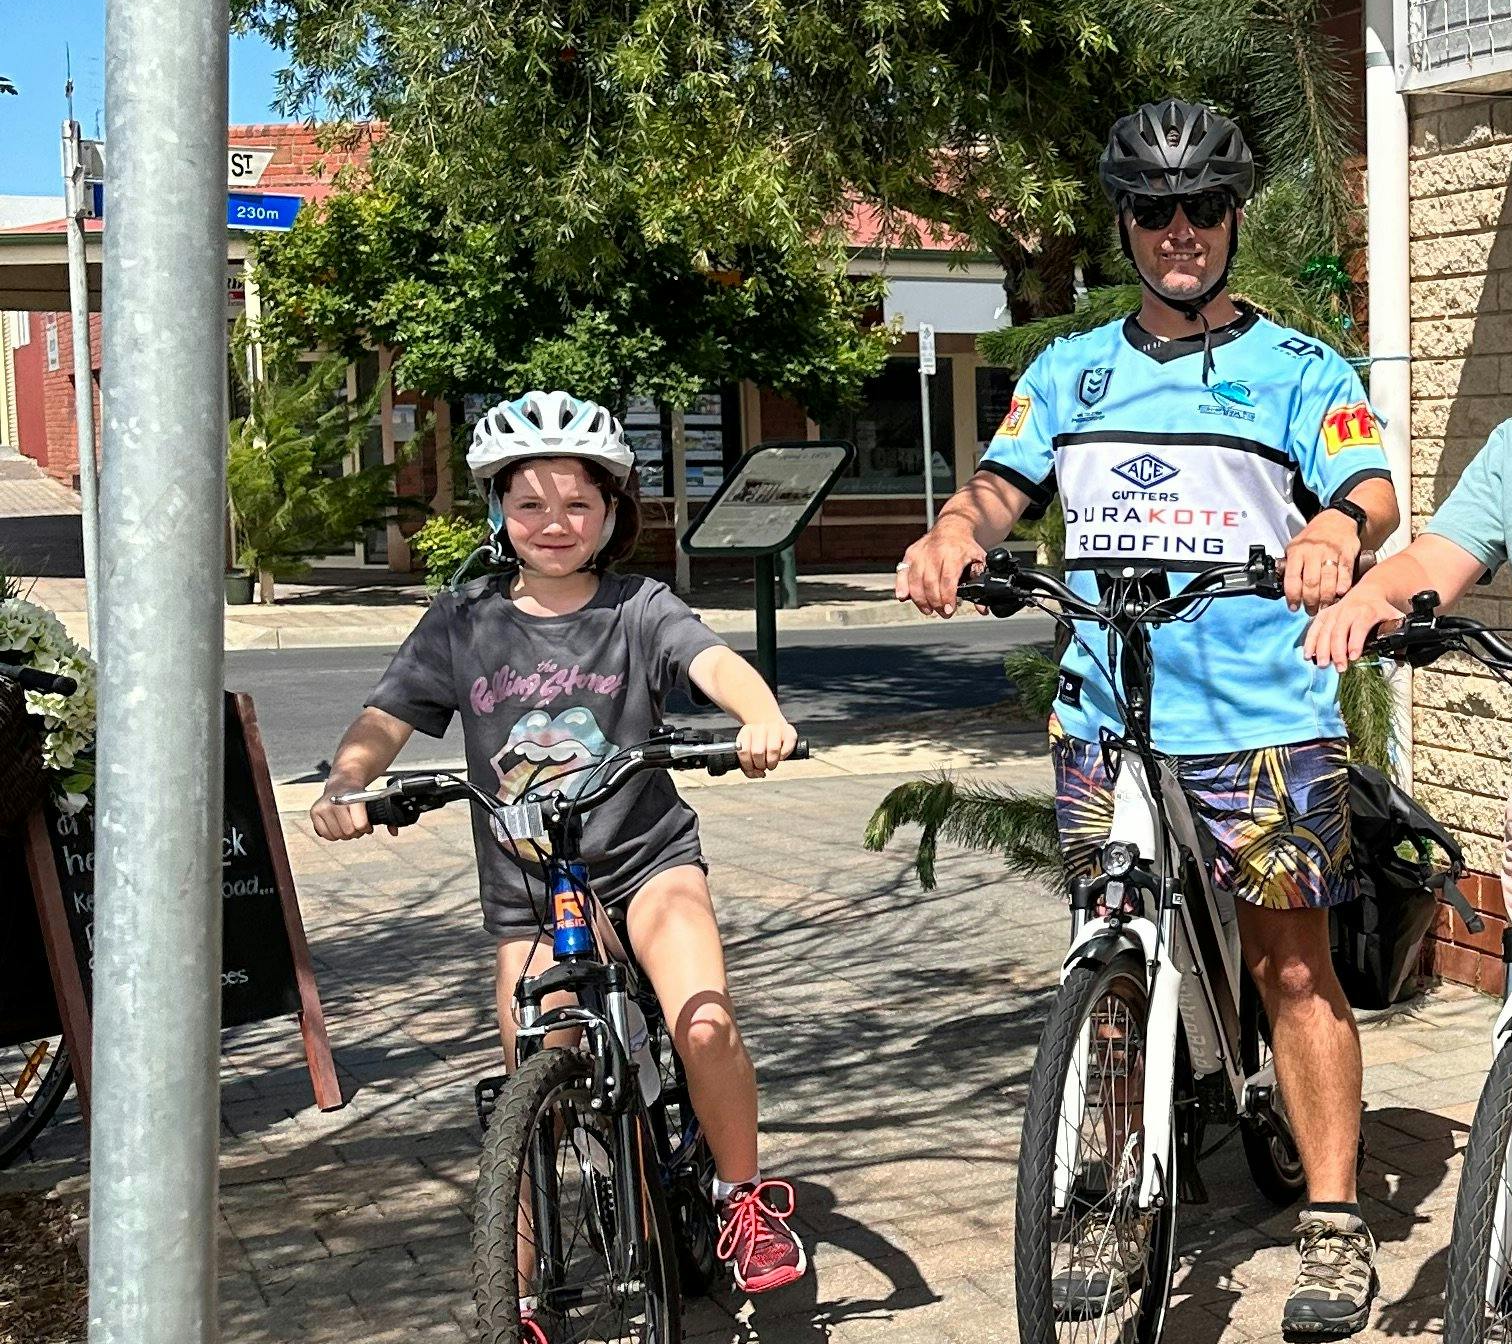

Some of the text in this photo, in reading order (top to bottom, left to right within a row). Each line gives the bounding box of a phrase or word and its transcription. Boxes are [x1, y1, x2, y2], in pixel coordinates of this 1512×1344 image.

[231, 153, 253, 177] ST
[236, 207, 279, 220] 230m
[1127, 457, 1164, 482] ACE
[1111, 490, 1180, 502] GUTTERS
[1079, 534, 1224, 555] ROOFING
[536, 659, 558, 673] the
[470, 664, 541, 716] Rolling
[556, 919, 587, 930] REID
